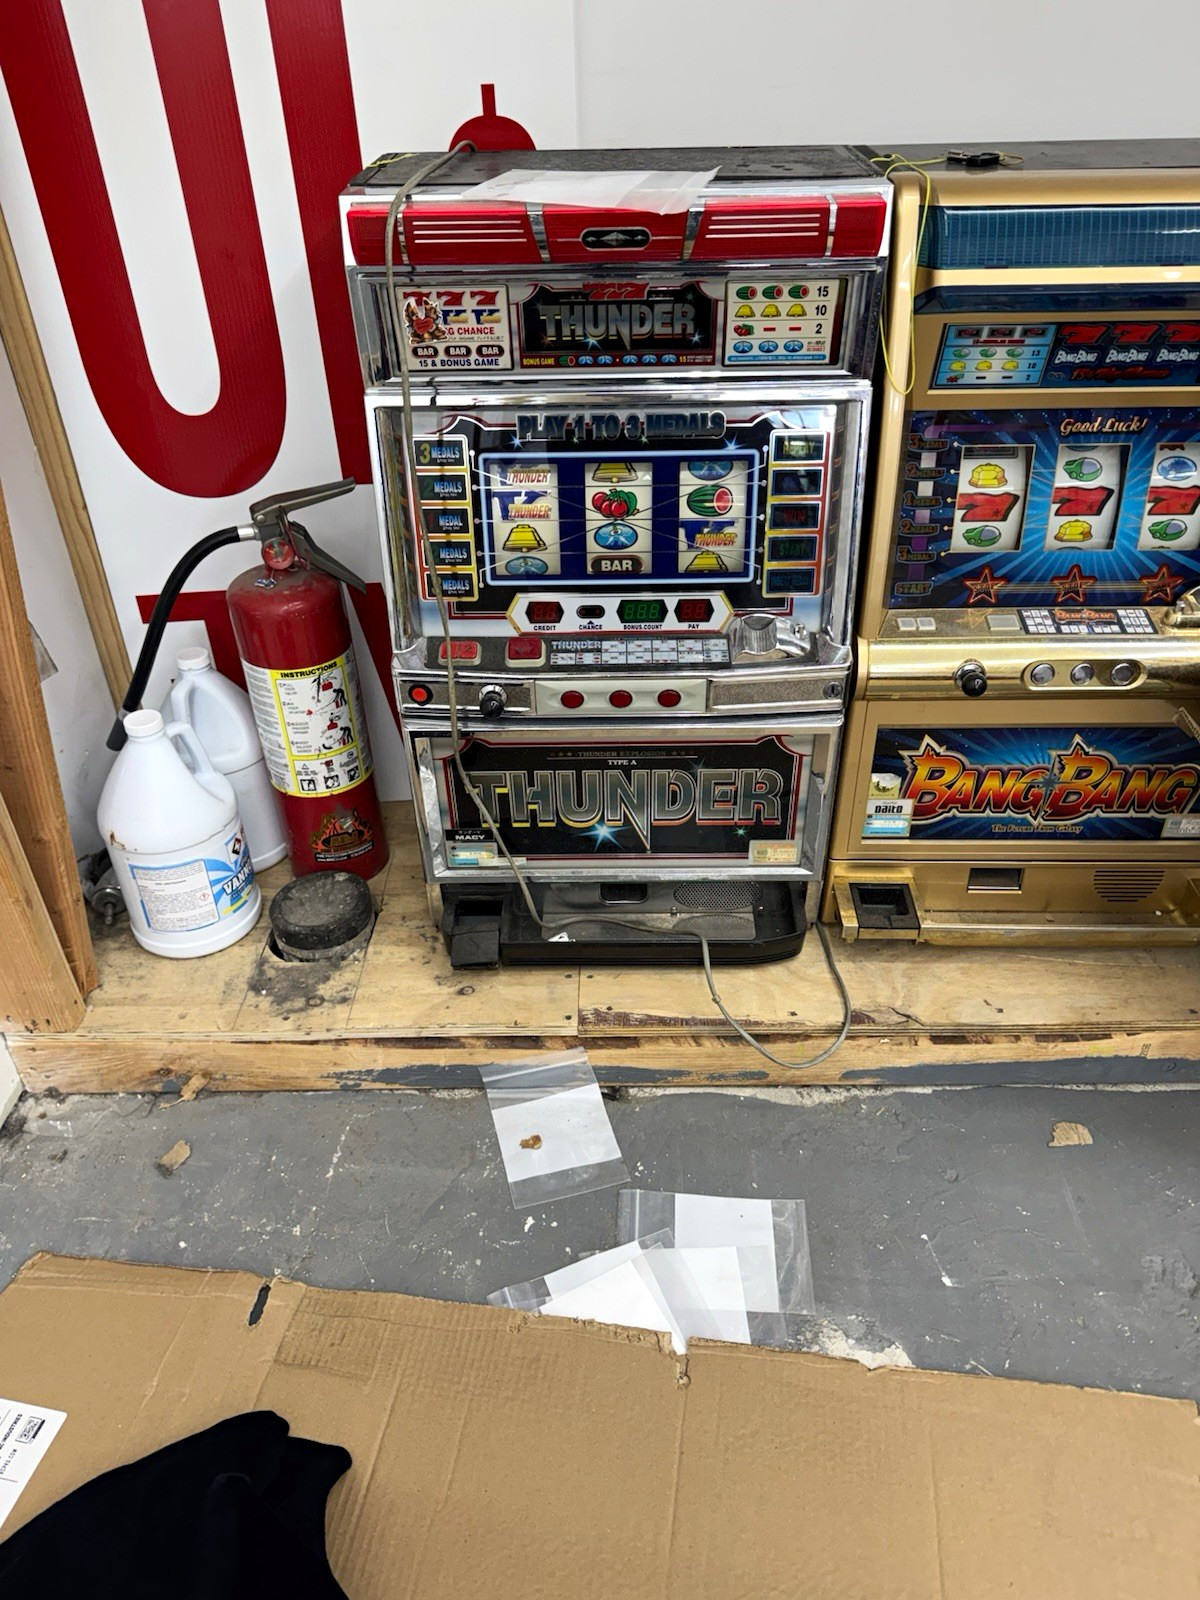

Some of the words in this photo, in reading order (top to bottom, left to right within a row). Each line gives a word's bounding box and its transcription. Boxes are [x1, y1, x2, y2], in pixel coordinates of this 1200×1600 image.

[817, 286, 829, 297] 15
[815, 305, 827, 316] 10
[457, 326, 496, 335] CHANCE
[539, 302, 697, 350] THUNDER
[815, 323, 823, 335] 2
[417, 348, 435, 356] BAR
[449, 346, 467, 356] BAR
[481, 346, 500, 356] BAR
[419, 360, 428, 368] 15
[431, 360, 437, 368] &
[440, 359, 472, 368] BONUS
[474, 358, 500, 367] GAME
[523, 358, 539, 366] BONUS
[540, 357, 555, 366] GAME
[516, 413, 570, 441] PLAY
[574, 412, 587, 440] 1
[590, 412, 621, 440] TO
[624, 412, 642, 440] 3
[645, 410, 726, 439] MEDALS
[1060, 417, 1101, 436] Good
[1102, 416, 1148, 433] Luck!
[420, 442, 431, 464] 3
[431, 446, 460, 459] MEDALS
[434, 481, 462, 493] MEDALS
[508, 504, 551, 520] THUNDER
[438, 514, 463, 527] MEDAL
[694, 533, 738, 547] THUNDER
[439, 546, 468, 559] MEDALS
[600, 560, 633, 573] BAR
[442, 578, 470, 591] MEDALS
[551, 640, 601, 650] THUNDER
[280, 661, 338, 679] INSTRUCTIONS
[619, 750, 667, 758] EXPLOSION
[900, 735, 1051, 820] BANG
[1044, 735, 1199, 824] BANG
[464, 769, 784, 853] THUNDER
